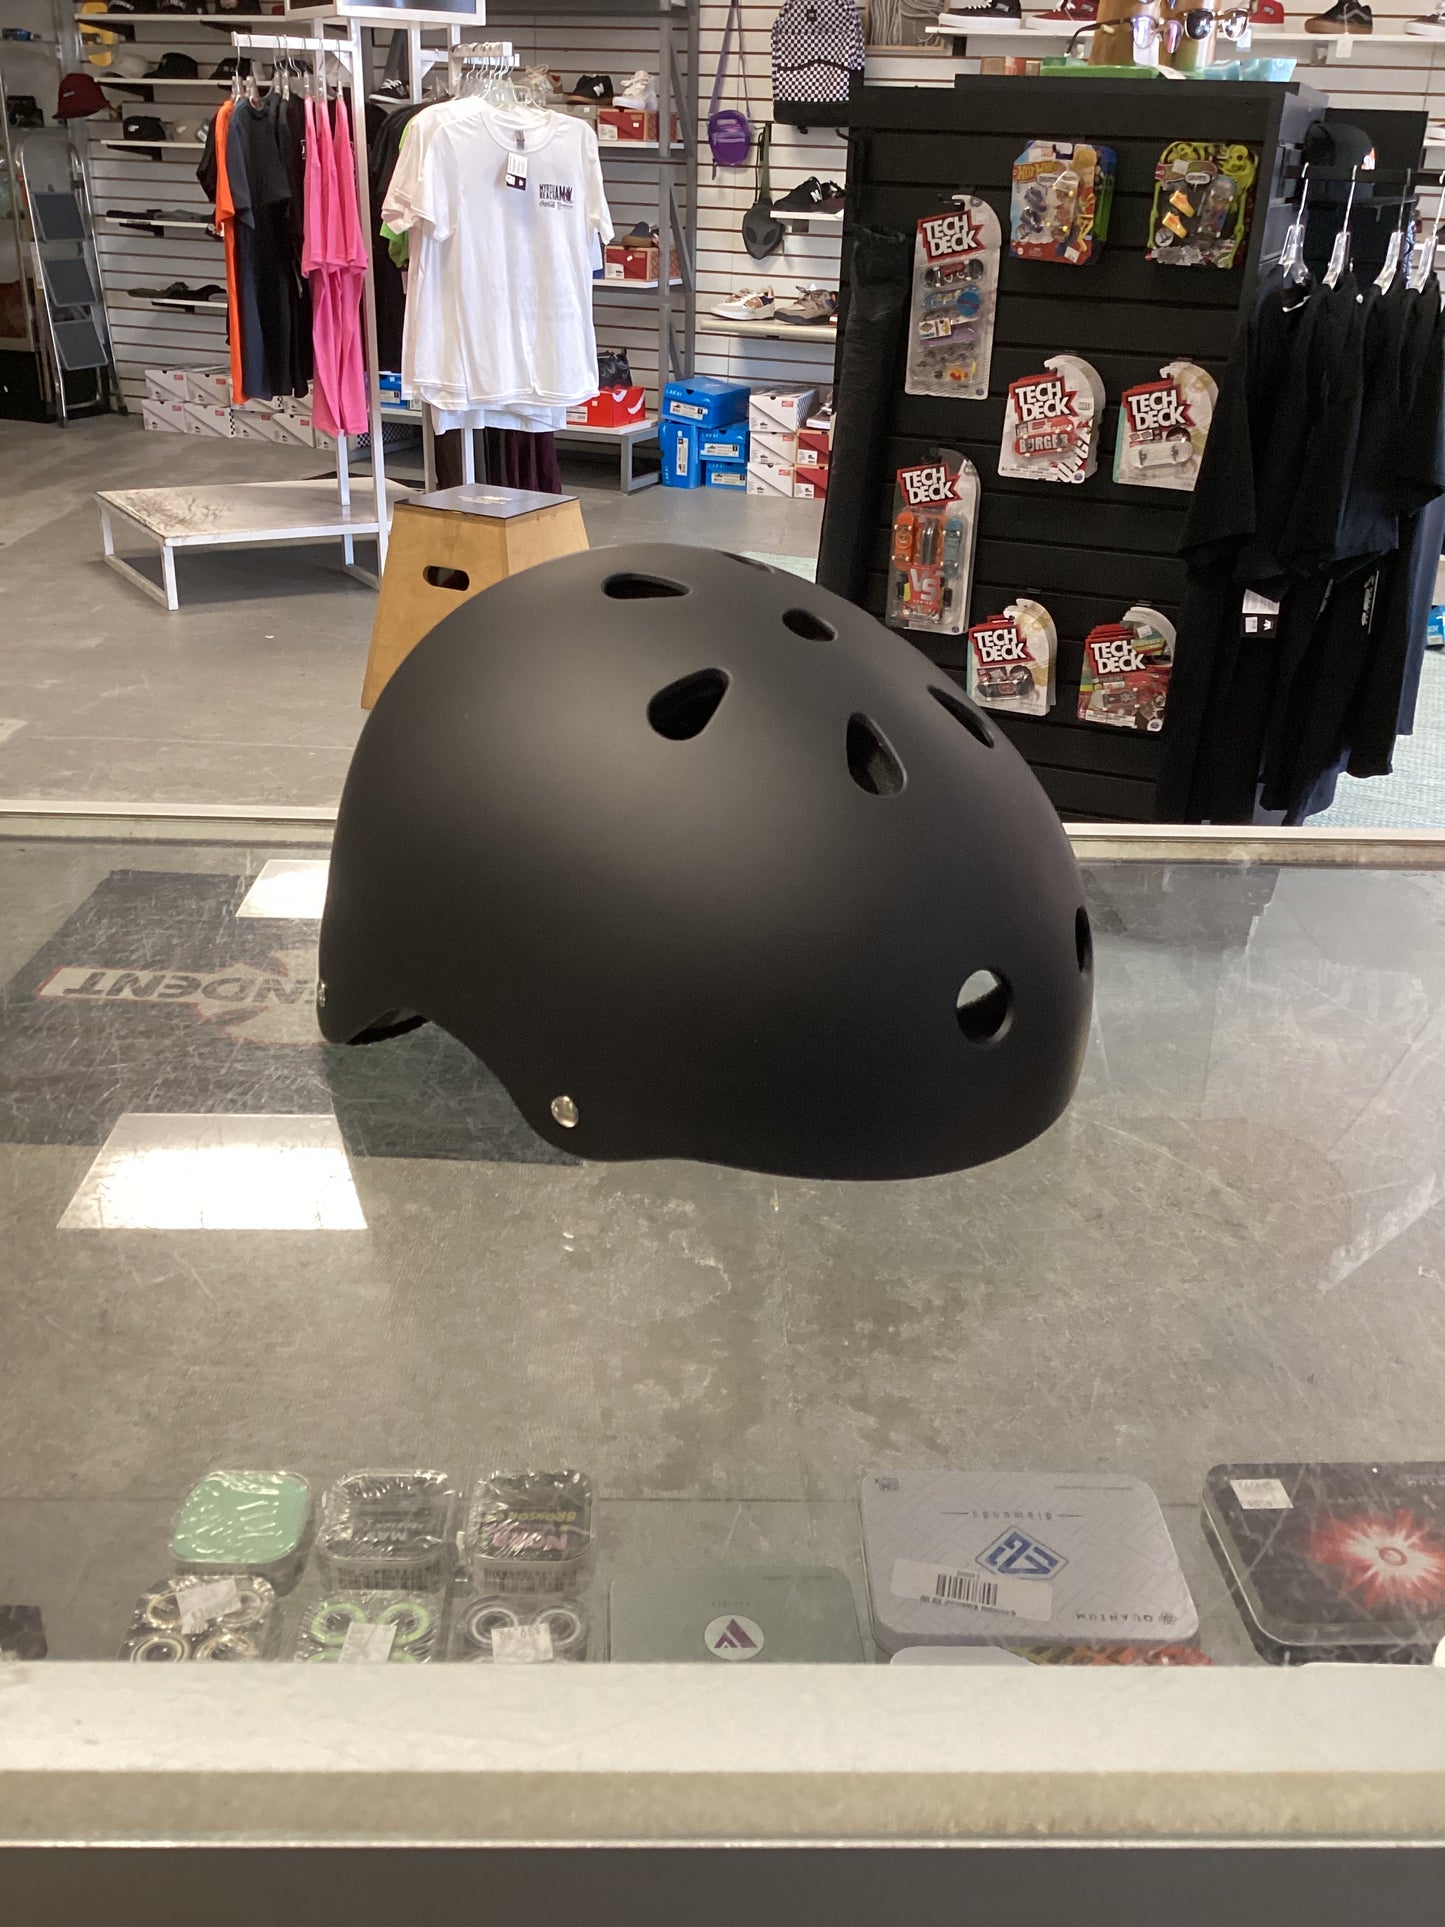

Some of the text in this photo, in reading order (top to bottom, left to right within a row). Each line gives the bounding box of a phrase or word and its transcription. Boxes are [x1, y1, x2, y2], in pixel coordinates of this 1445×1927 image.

[923, 214, 968, 240] TECH
[930, 230, 977, 256] DECK
[1015, 381, 1062, 407] TECH
[1127, 389, 1177, 415] TECH
[1021, 396, 1070, 421] DECK
[1135, 405, 1186, 430] DECK
[902, 466, 946, 490] TECH
[908, 481, 954, 504] DECK
[910, 568, 938, 601] VS
[974, 628, 1018, 650] TECH
[1090, 640, 1137, 661] TECH
[981, 641, 1027, 663] DECK
[1097, 652, 1146, 674] DECK
[508, 1511, 577, 1523] BRONSON
[1075, 1612, 1154, 1623] QUANTUM
